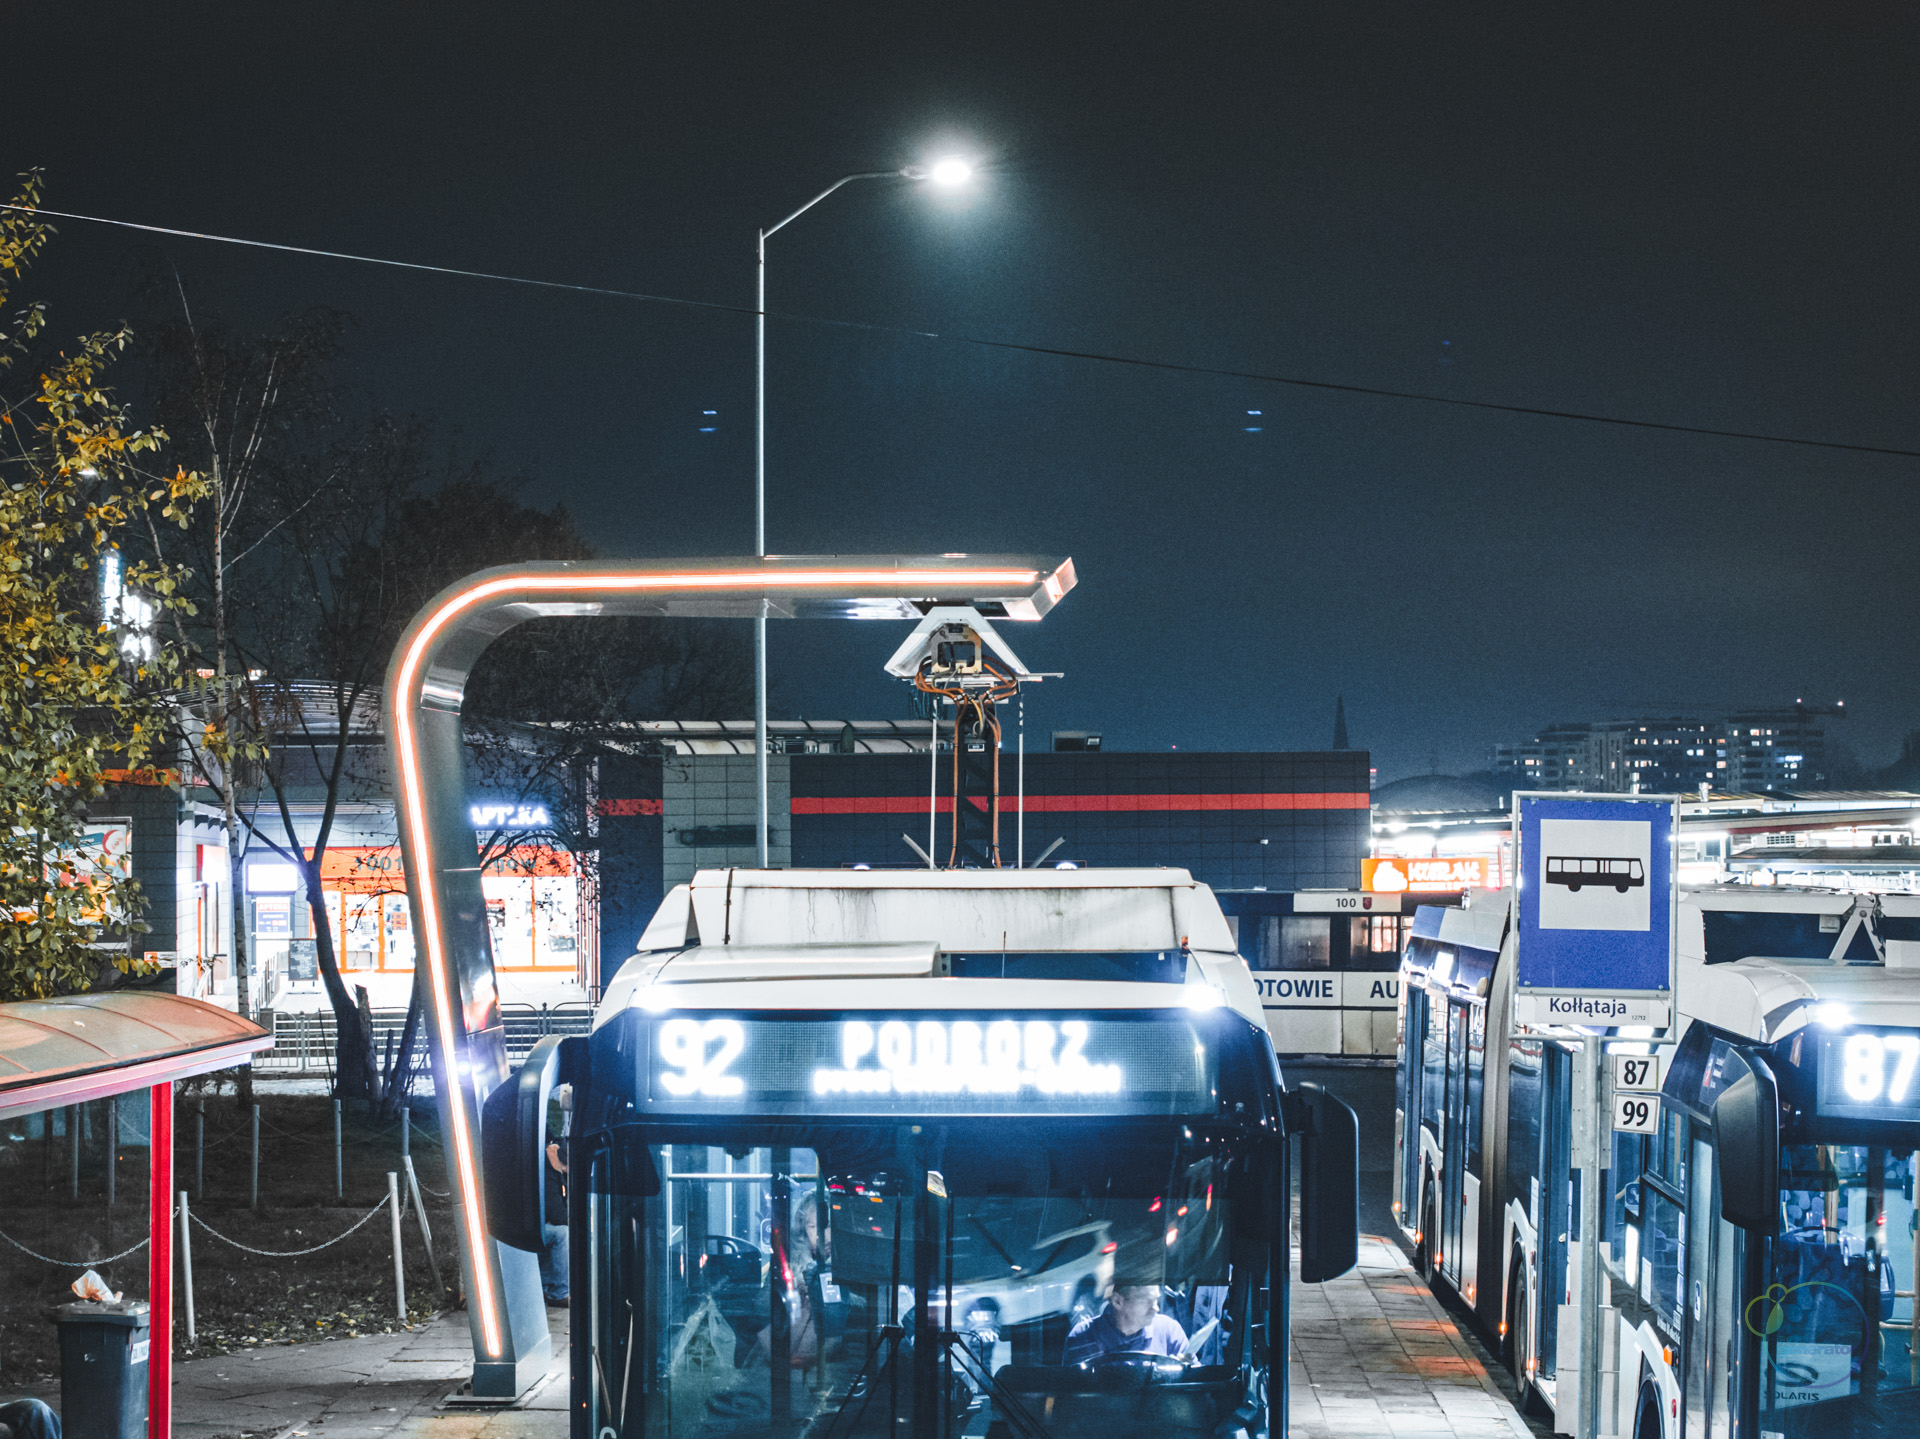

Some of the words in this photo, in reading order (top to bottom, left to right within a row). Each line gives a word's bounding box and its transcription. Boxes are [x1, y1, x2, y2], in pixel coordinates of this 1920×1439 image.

[1336, 898, 1357, 908] 100
[1549, 997, 1627, 1018] Kołłątaja
[659, 1018, 745, 1096] 92
[1843, 1033, 1920, 1103] 87
[1623, 1060, 1650, 1085] 87
[1622, 1100, 1649, 1127] 99
